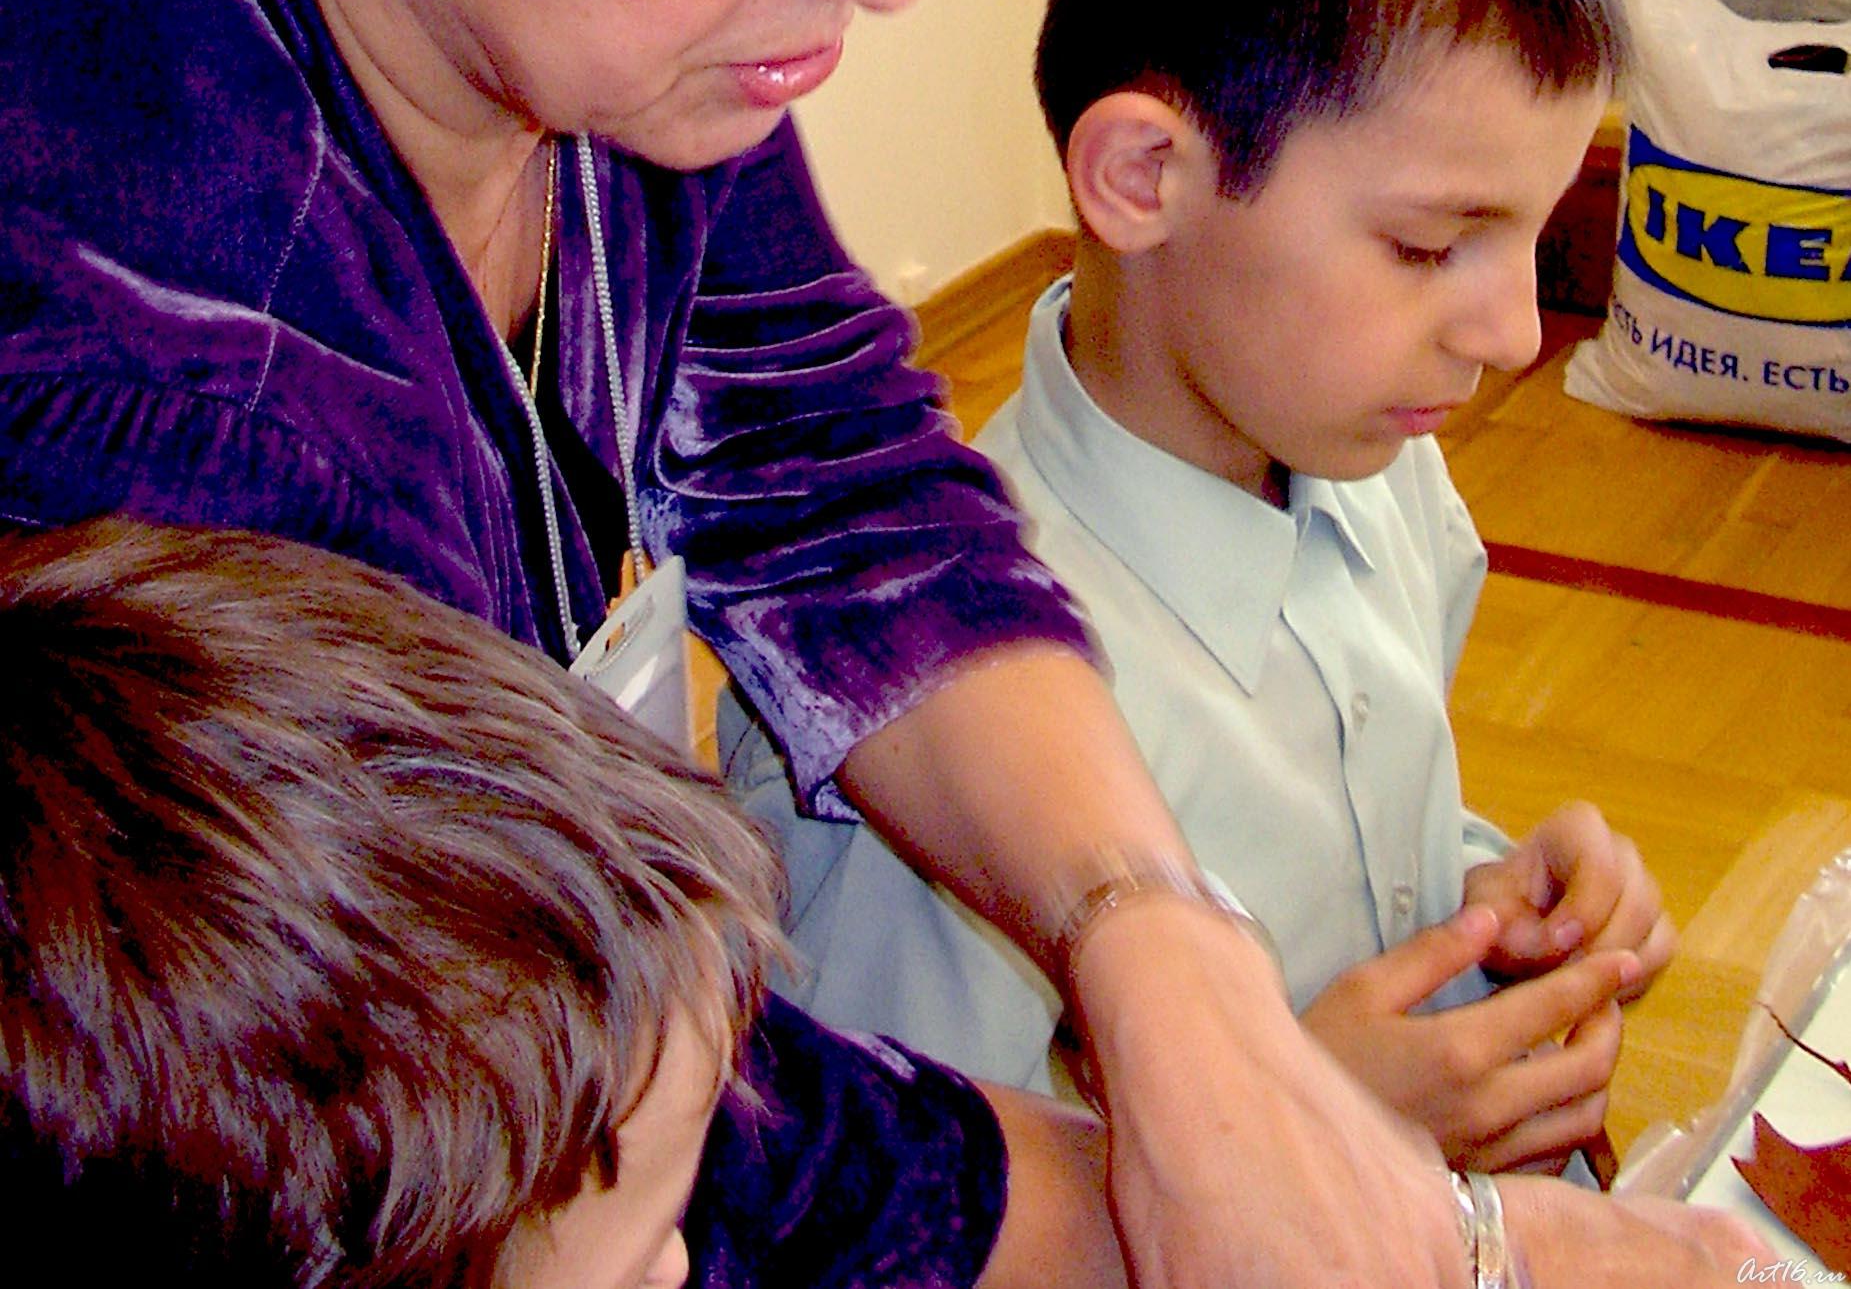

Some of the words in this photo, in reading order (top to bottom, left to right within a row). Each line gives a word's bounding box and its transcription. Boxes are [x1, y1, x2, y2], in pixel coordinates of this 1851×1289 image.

[1646, 185, 1851, 281] IKE
[1613, 296, 1642, 344] СТЬ
[1651, 326, 1749, 382] ИДЕЯ.
[1763, 361, 1850, 394] ЕСТЬ
